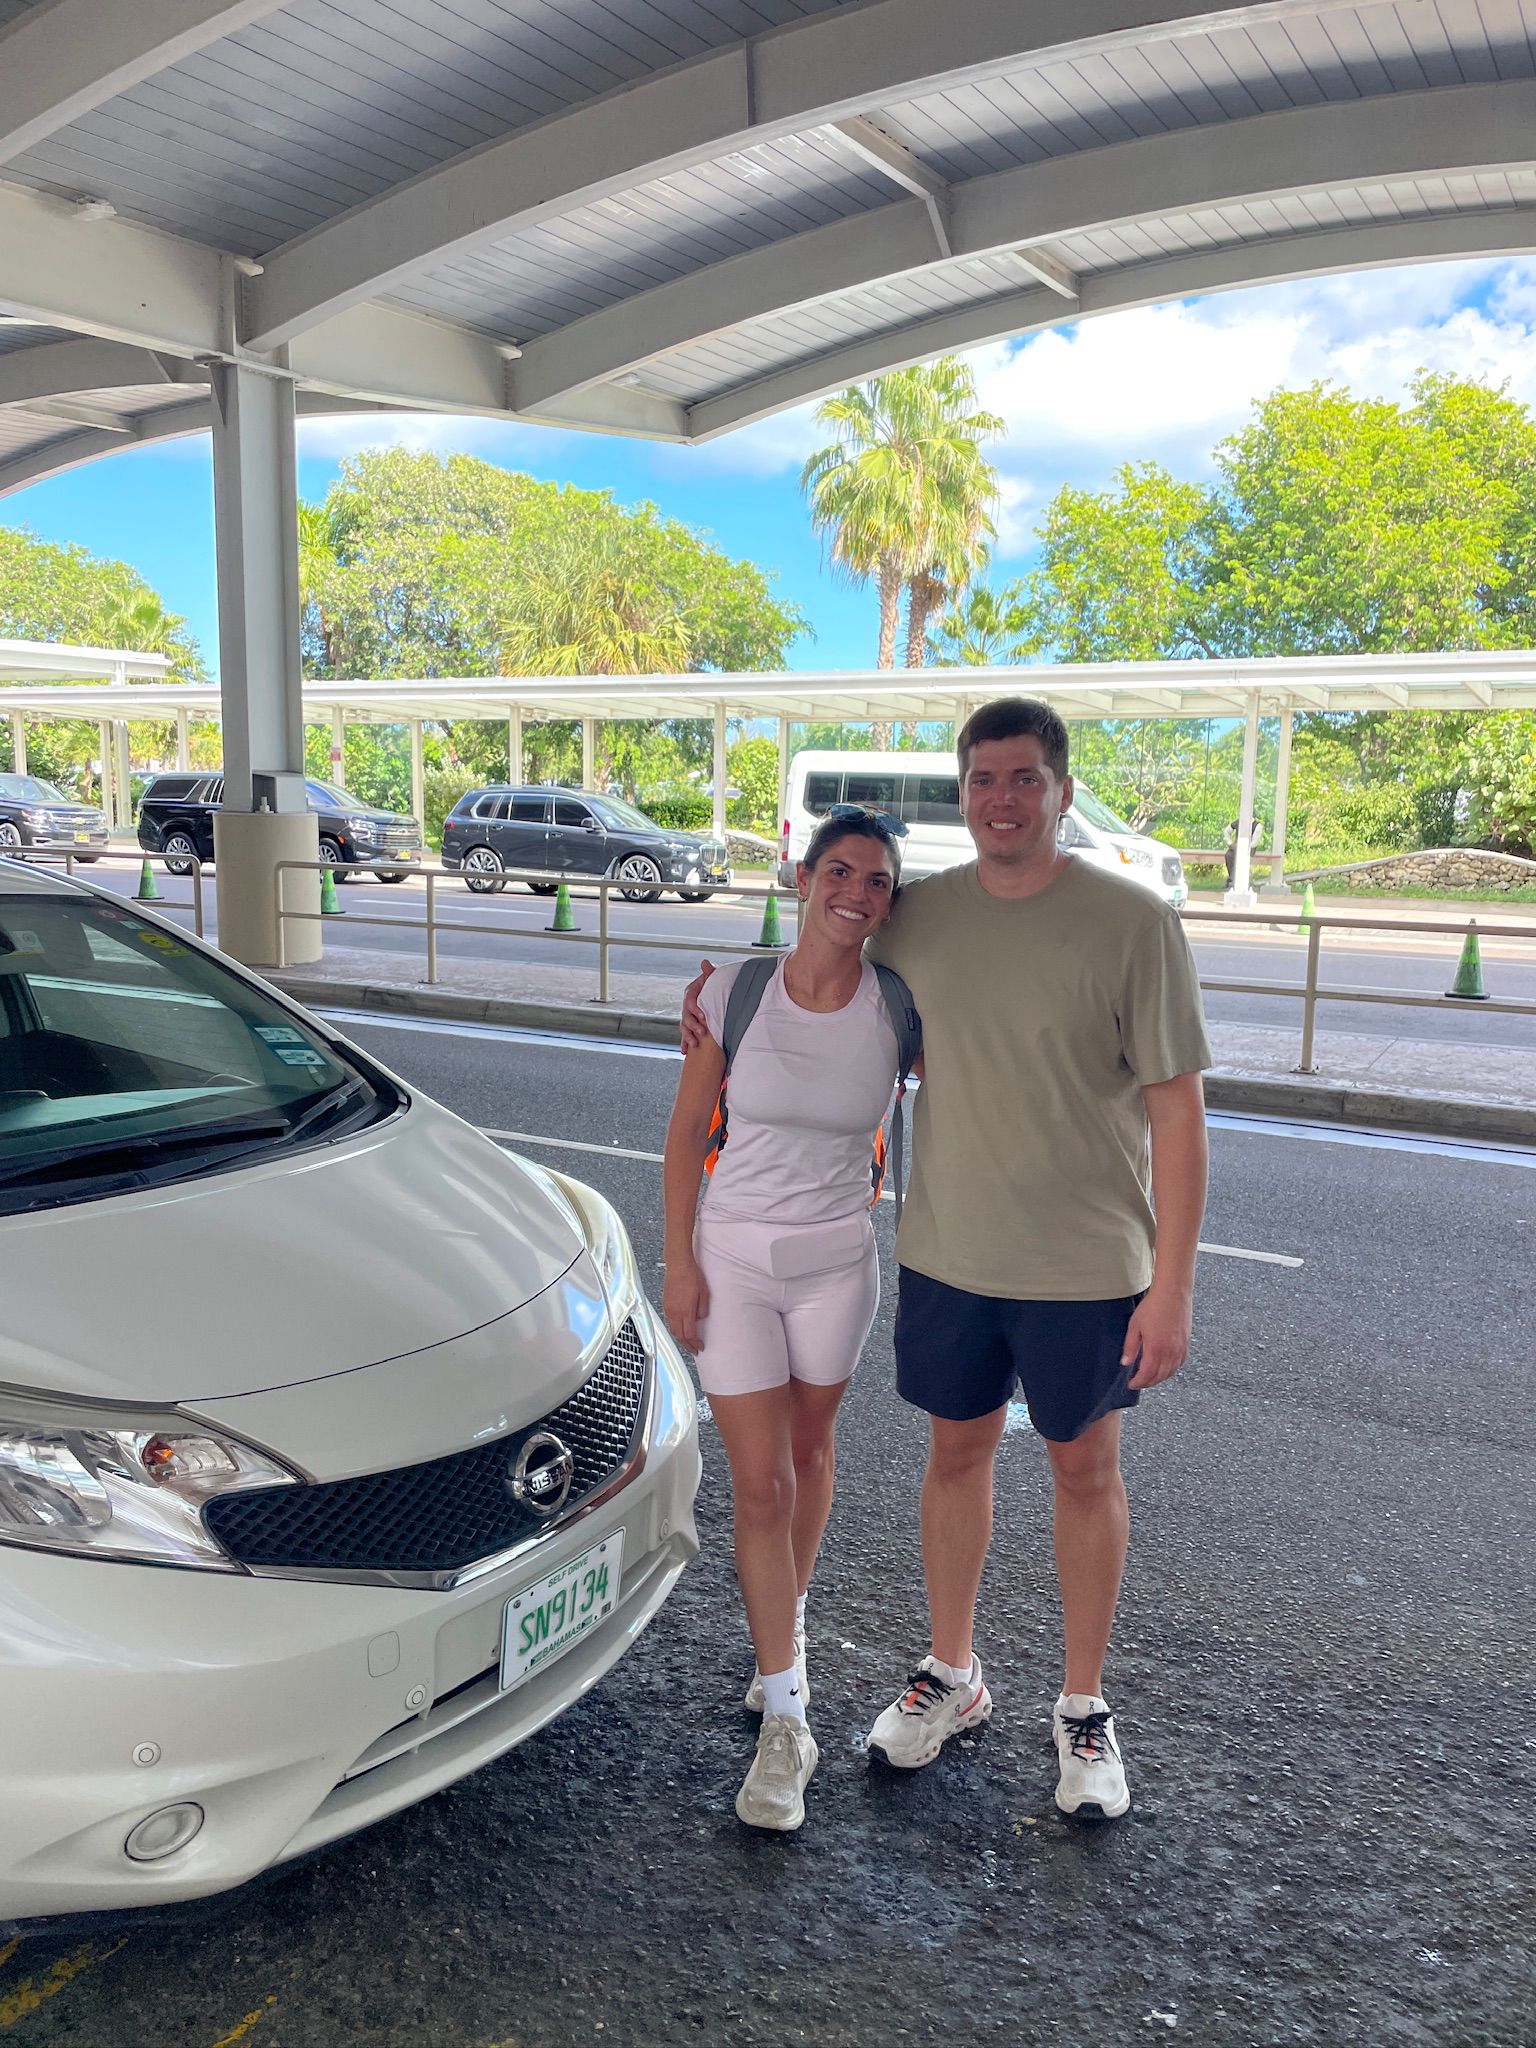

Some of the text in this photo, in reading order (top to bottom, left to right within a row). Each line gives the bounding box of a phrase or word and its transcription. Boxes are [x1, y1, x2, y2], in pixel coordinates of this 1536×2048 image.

[548, 1556, 588, 1588] SELF DRIVE
[518, 1561, 609, 1656] SN9134
[542, 1623, 582, 1658] BAHAMAS
